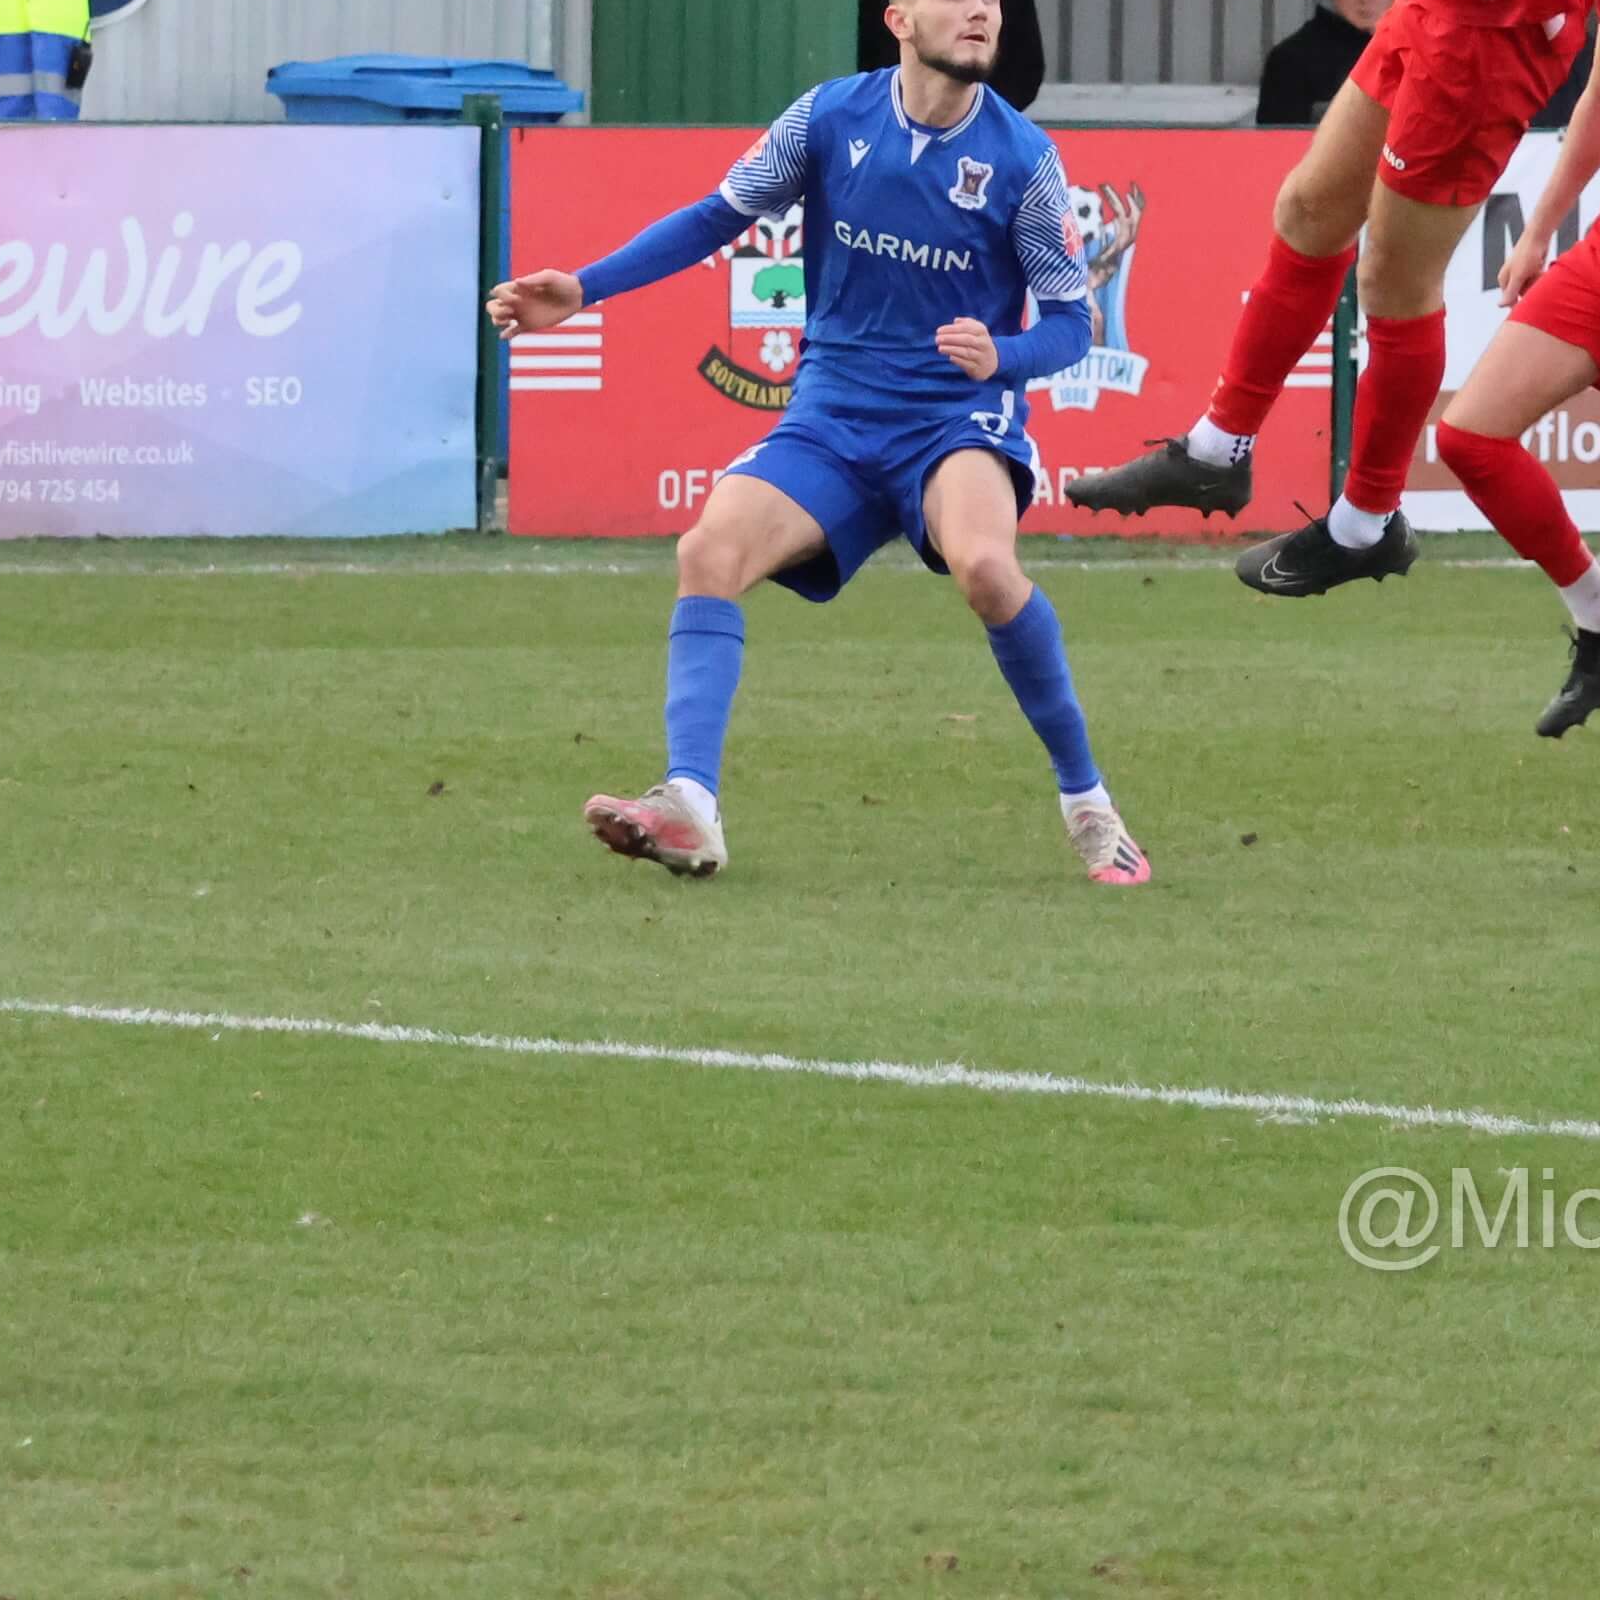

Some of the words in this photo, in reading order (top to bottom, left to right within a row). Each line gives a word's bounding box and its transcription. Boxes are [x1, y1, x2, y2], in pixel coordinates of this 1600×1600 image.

[834, 219, 971, 273] GARMIN
[78, 376, 208, 408] Websites
[245, 376, 303, 406] SEO
[37, 478, 75, 503] 725
[81, 478, 120, 503] 454
